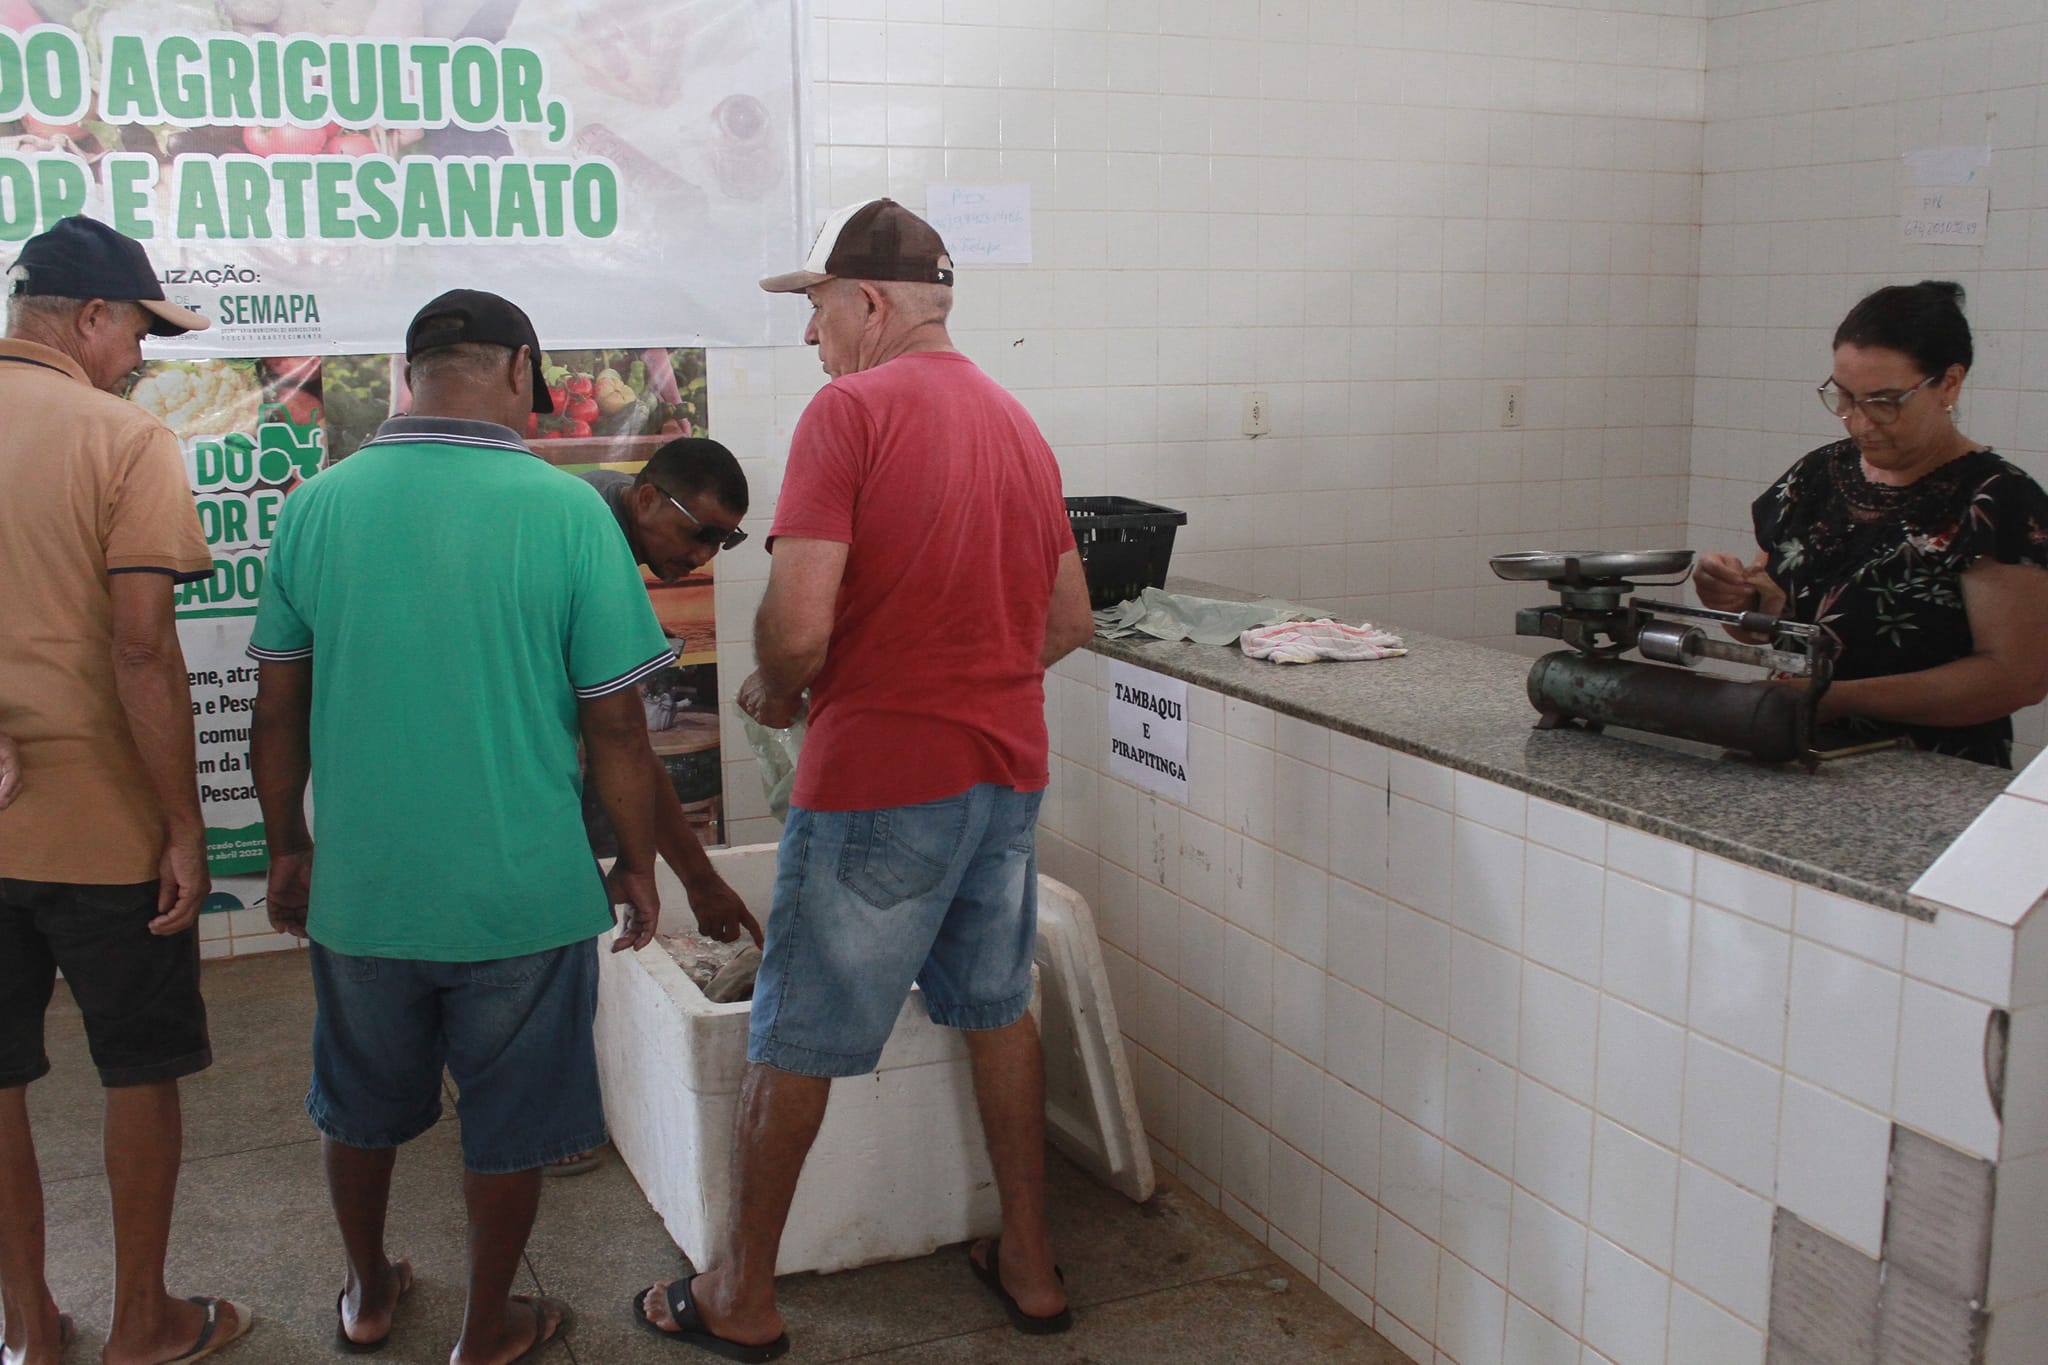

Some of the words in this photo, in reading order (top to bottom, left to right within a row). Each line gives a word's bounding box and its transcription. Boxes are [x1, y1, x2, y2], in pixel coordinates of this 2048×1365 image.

[107, 36, 566, 142] AGRICULTOR,
[110, 160, 154, 240] E
[176, 160, 618, 239] ARTESANATO
[219, 294, 320, 325] SEMAPA
[196, 438, 253, 486] DO
[205, 701, 216, 715] e
[1114, 682, 1182, 721] TAMBAQUI
[1142, 722, 1151, 739] E
[219, 752, 241, 772] da
[1112, 738, 1187, 781] PIRAPITINGA
